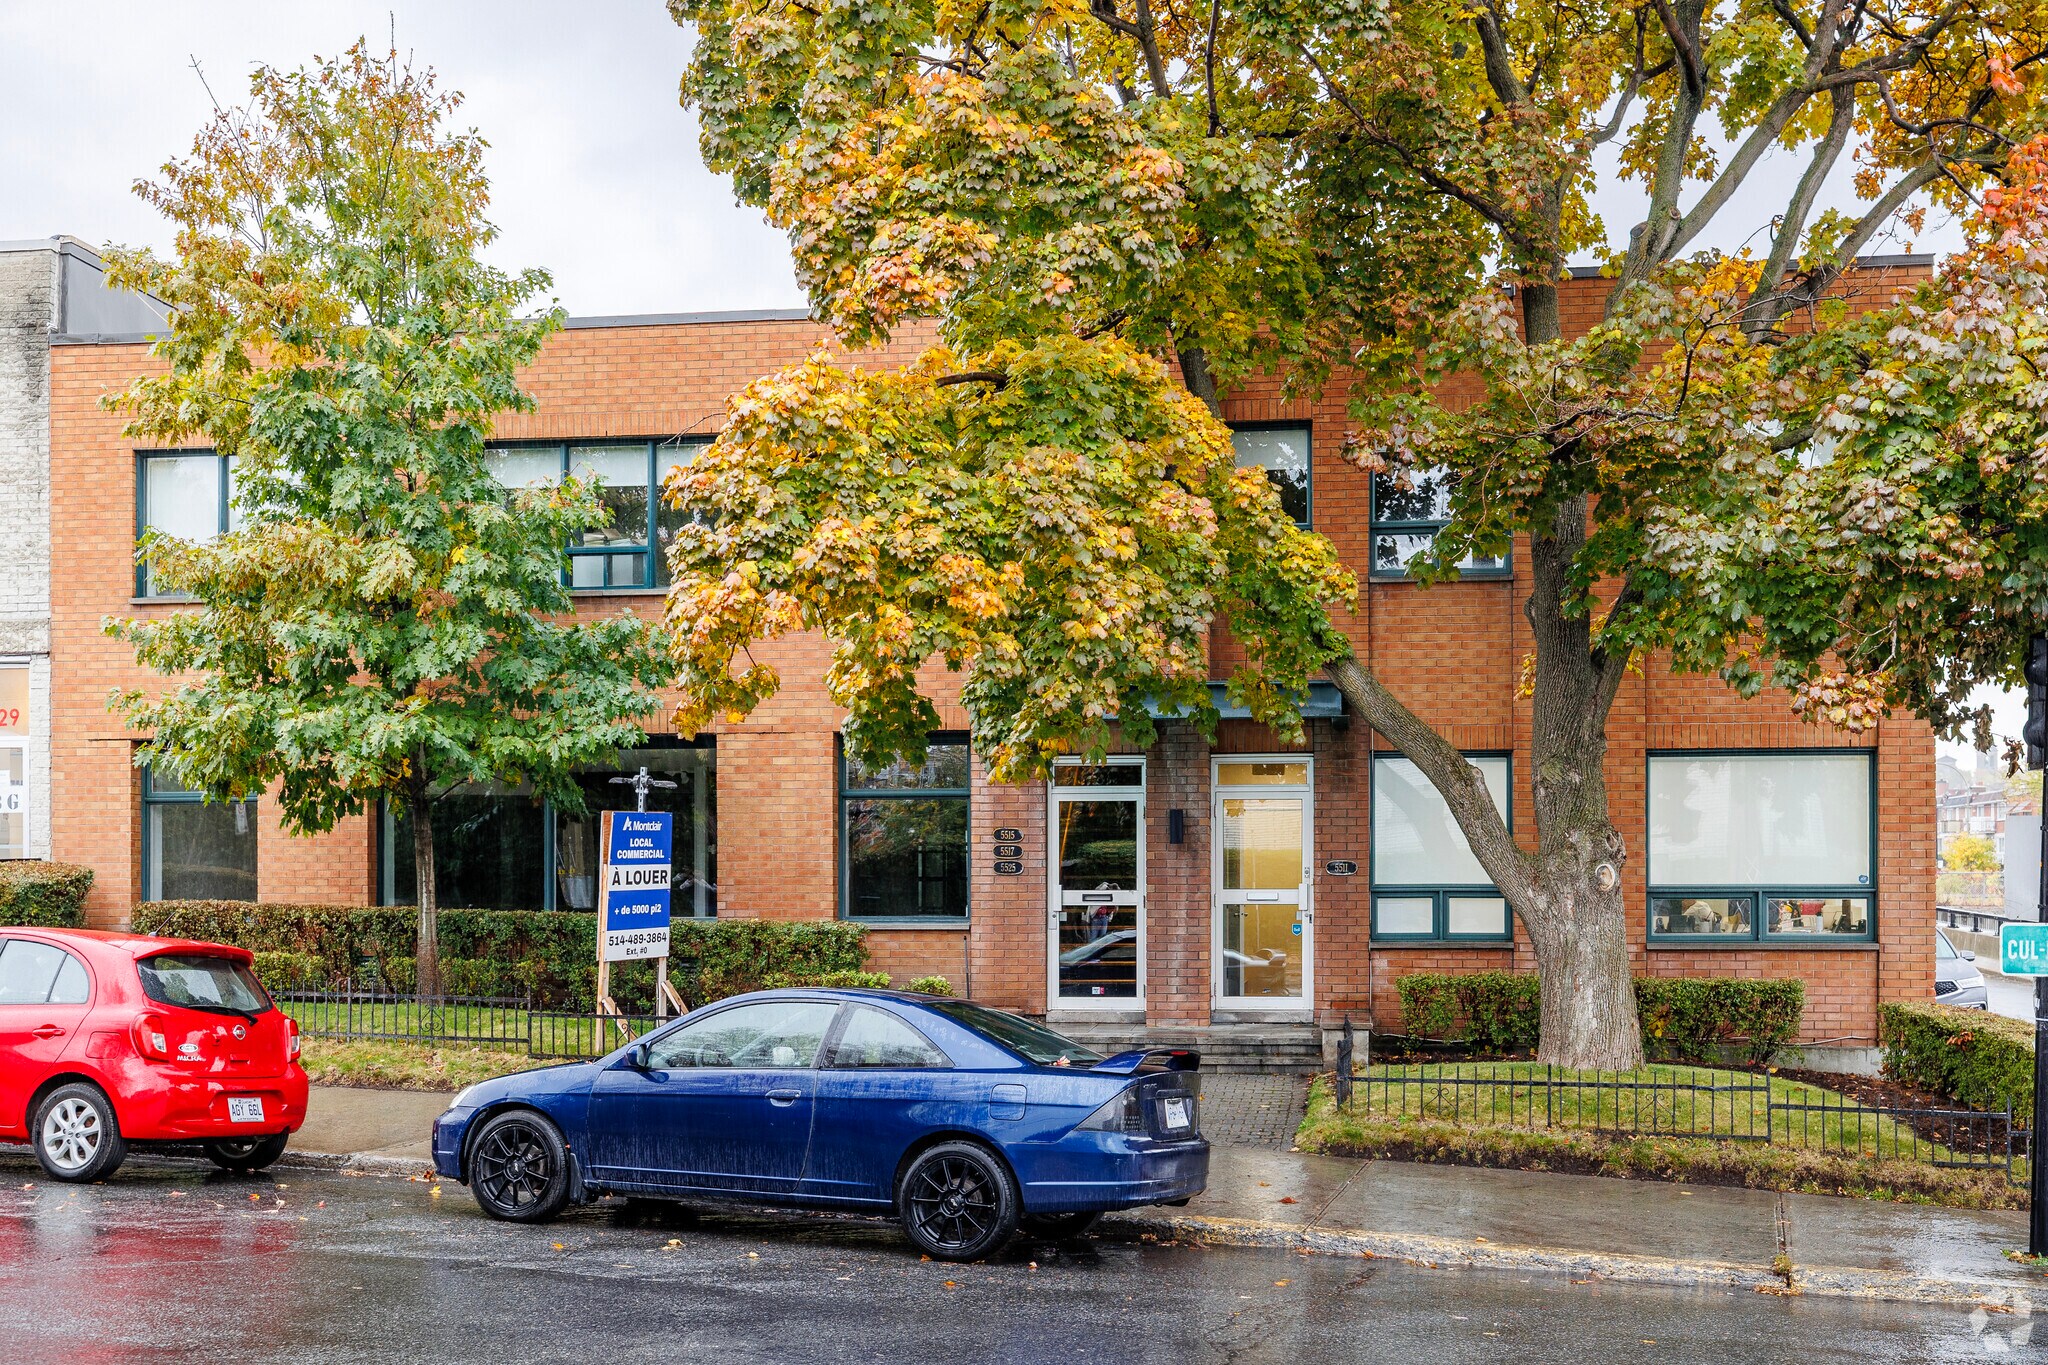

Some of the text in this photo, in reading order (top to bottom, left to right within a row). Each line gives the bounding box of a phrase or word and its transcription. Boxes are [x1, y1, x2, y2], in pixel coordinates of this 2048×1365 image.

[0, 708, 19, 726] 29
[632, 820, 662, 831] Montclair
[1000, 830, 1015, 839] 5515
[629, 838, 653, 847] LOCAL
[616, 849, 665, 859] COMMERCIAL
[1000, 846, 1015, 856] 5517
[1000, 862, 1016, 872] 5525
[1334, 863, 1348, 873] 5511
[611, 866, 668, 886] À LOUER
[620, 904, 631, 915] de
[631, 904, 649, 914] 5000
[650, 903, 662, 915] pi2
[608, 931, 667, 947] 514-489-3864
[2007, 939, 2048, 961] CUL-
[231, 1103, 262, 1116] AGY 66L
